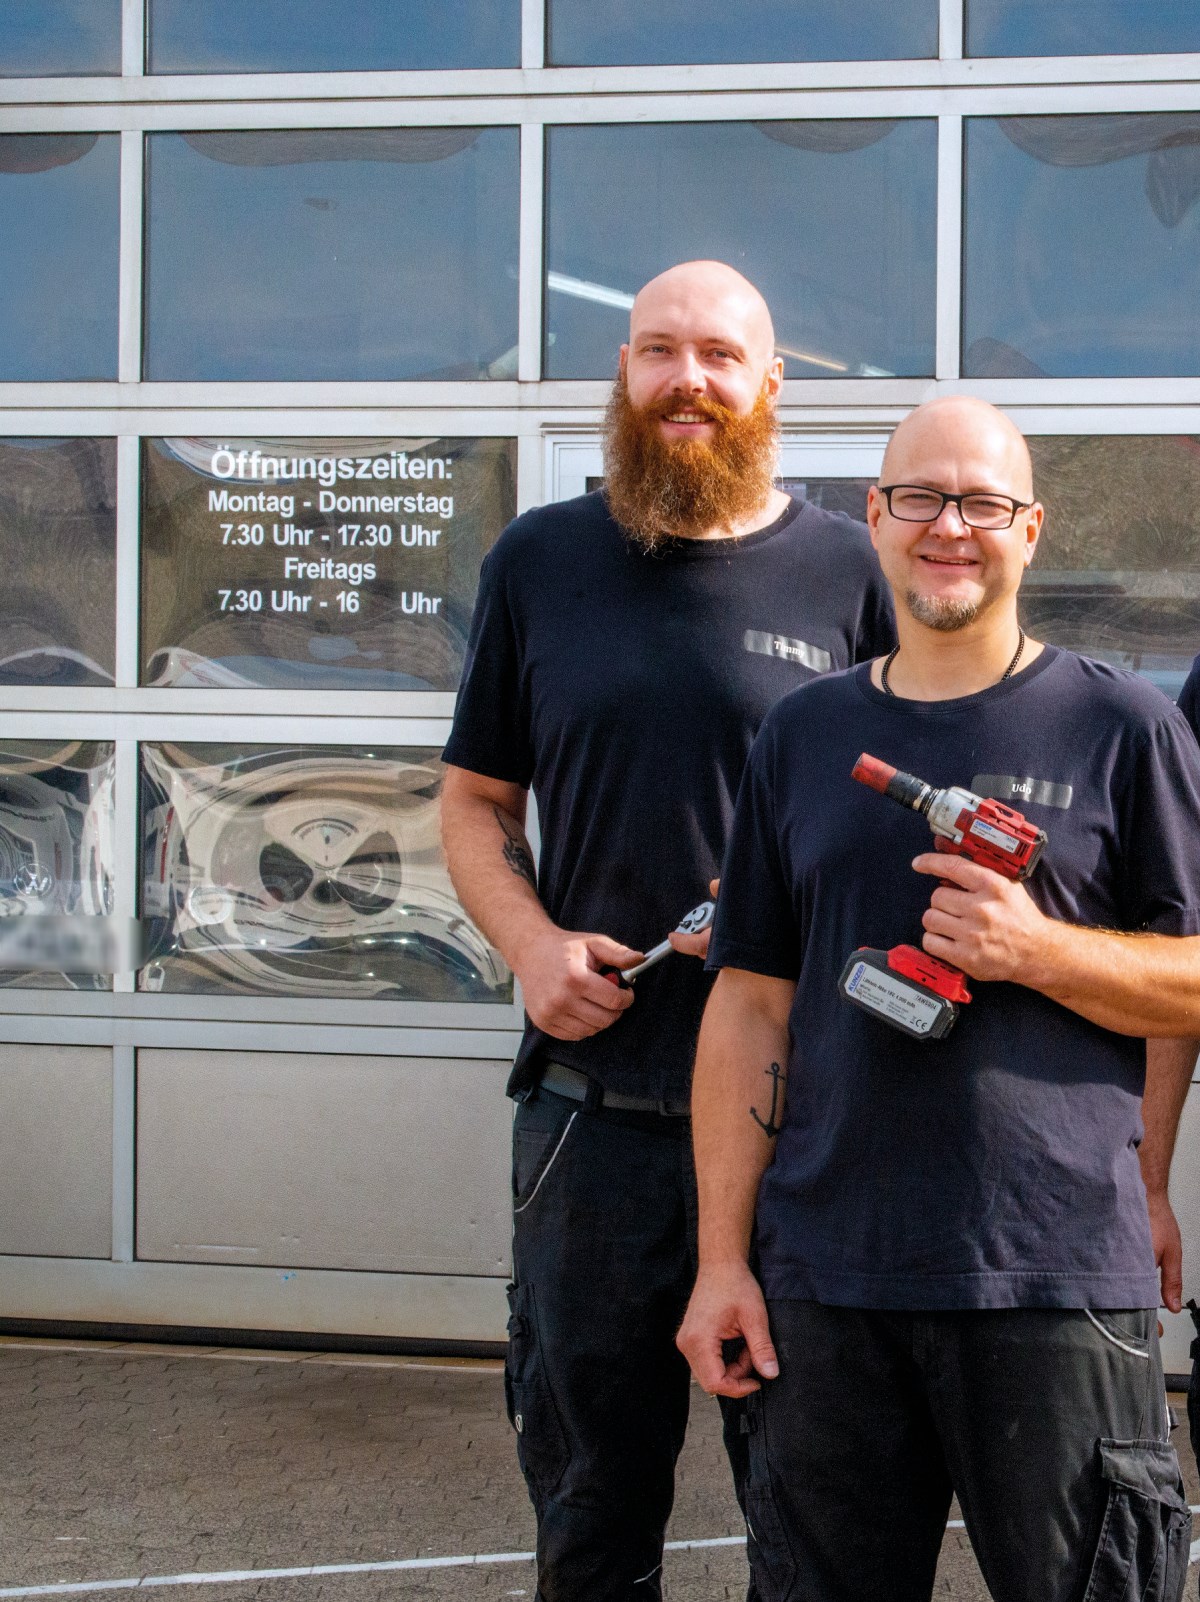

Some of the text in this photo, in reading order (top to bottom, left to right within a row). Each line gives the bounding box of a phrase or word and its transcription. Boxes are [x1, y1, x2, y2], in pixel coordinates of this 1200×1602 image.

[211, 445, 453, 487] Öffnungszeiten:
[208, 490, 295, 518] Montag
[319, 491, 454, 519] Donnerstag
[219, 524, 264, 545] 7.30
[273, 524, 313, 546] Uhr
[338, 524, 392, 547] 17.30
[400, 525, 441, 547] Uhr
[284, 557, 376, 586] Freitags
[218, 590, 262, 612] 7.30
[271, 590, 312, 612] Uhr
[336, 591, 360, 613] 16
[401, 592, 442, 614] Uhr
[773, 640, 805, 658] Timmy
[1011, 783, 1032, 794] Udo
[848, 964, 865, 991] KUNZER
